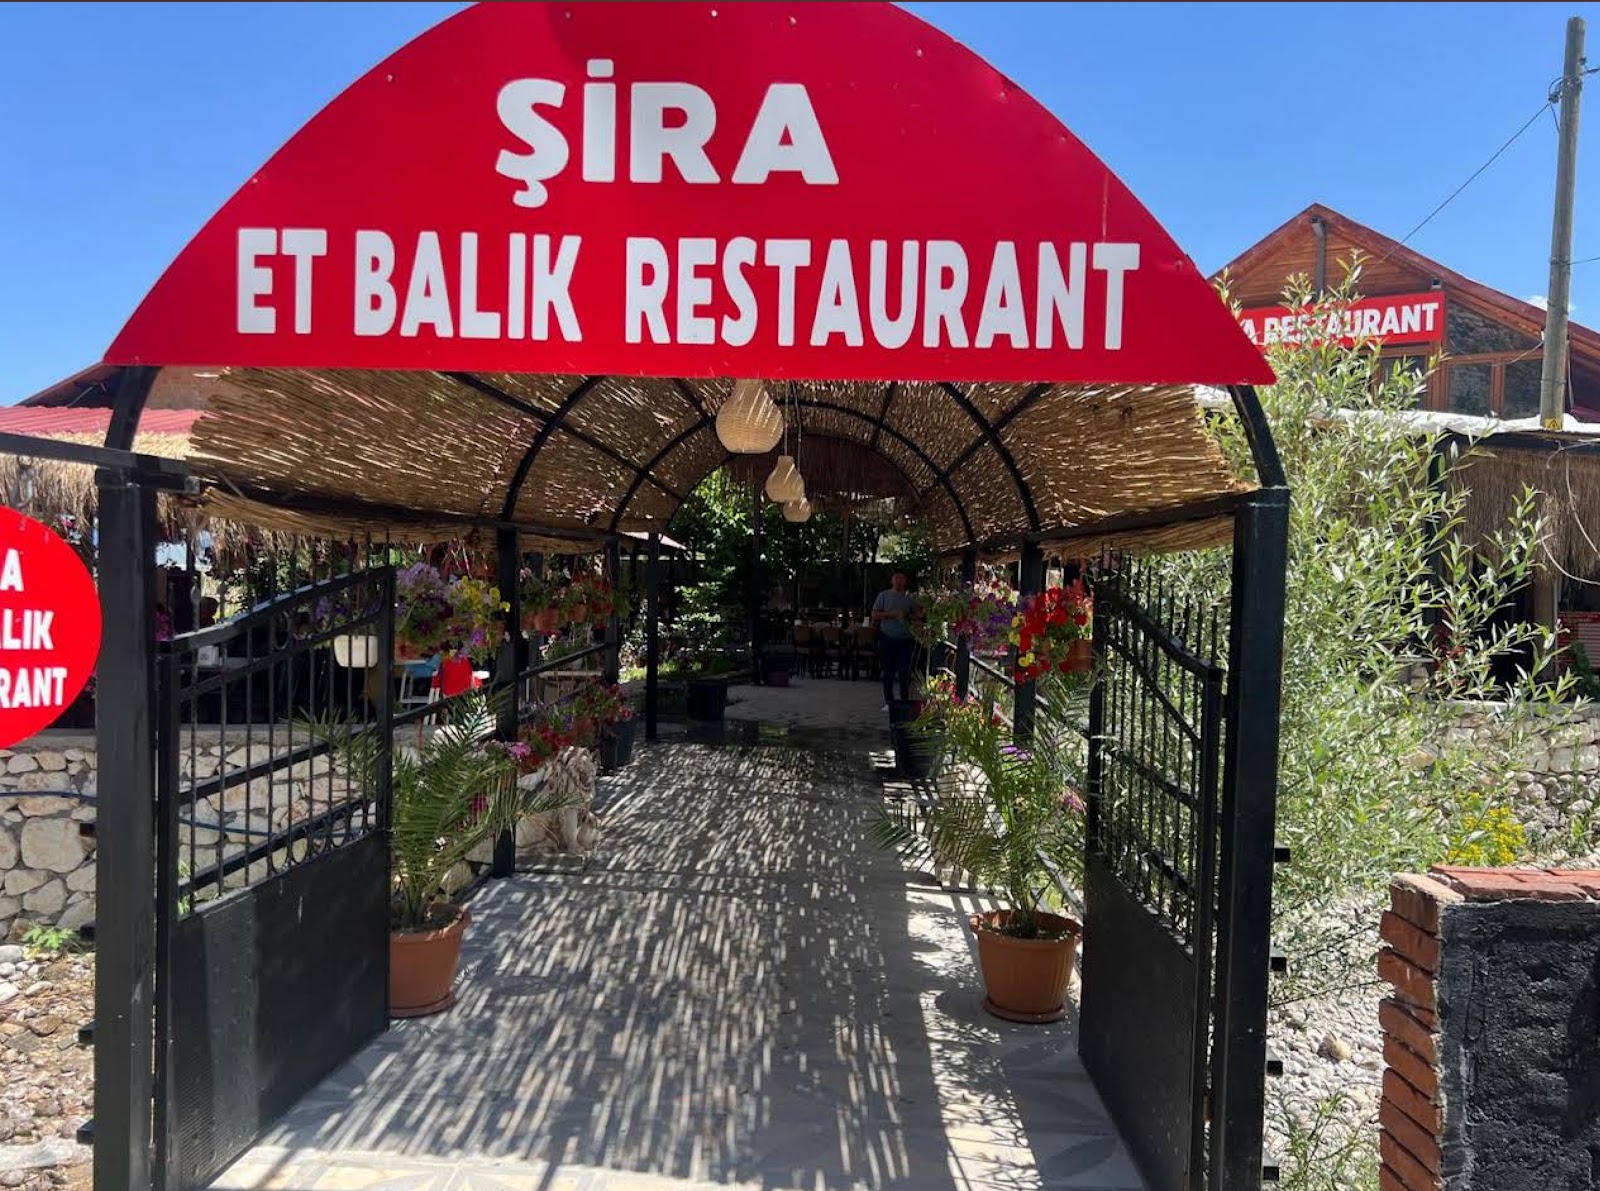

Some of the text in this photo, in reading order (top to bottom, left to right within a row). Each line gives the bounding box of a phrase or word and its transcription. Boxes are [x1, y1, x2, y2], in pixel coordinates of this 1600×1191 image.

[495, 59, 839, 208] ŞİRA
[236, 228, 1141, 351] ET BALIK RESTAURANT
[0, 608, 54, 650] LIK
